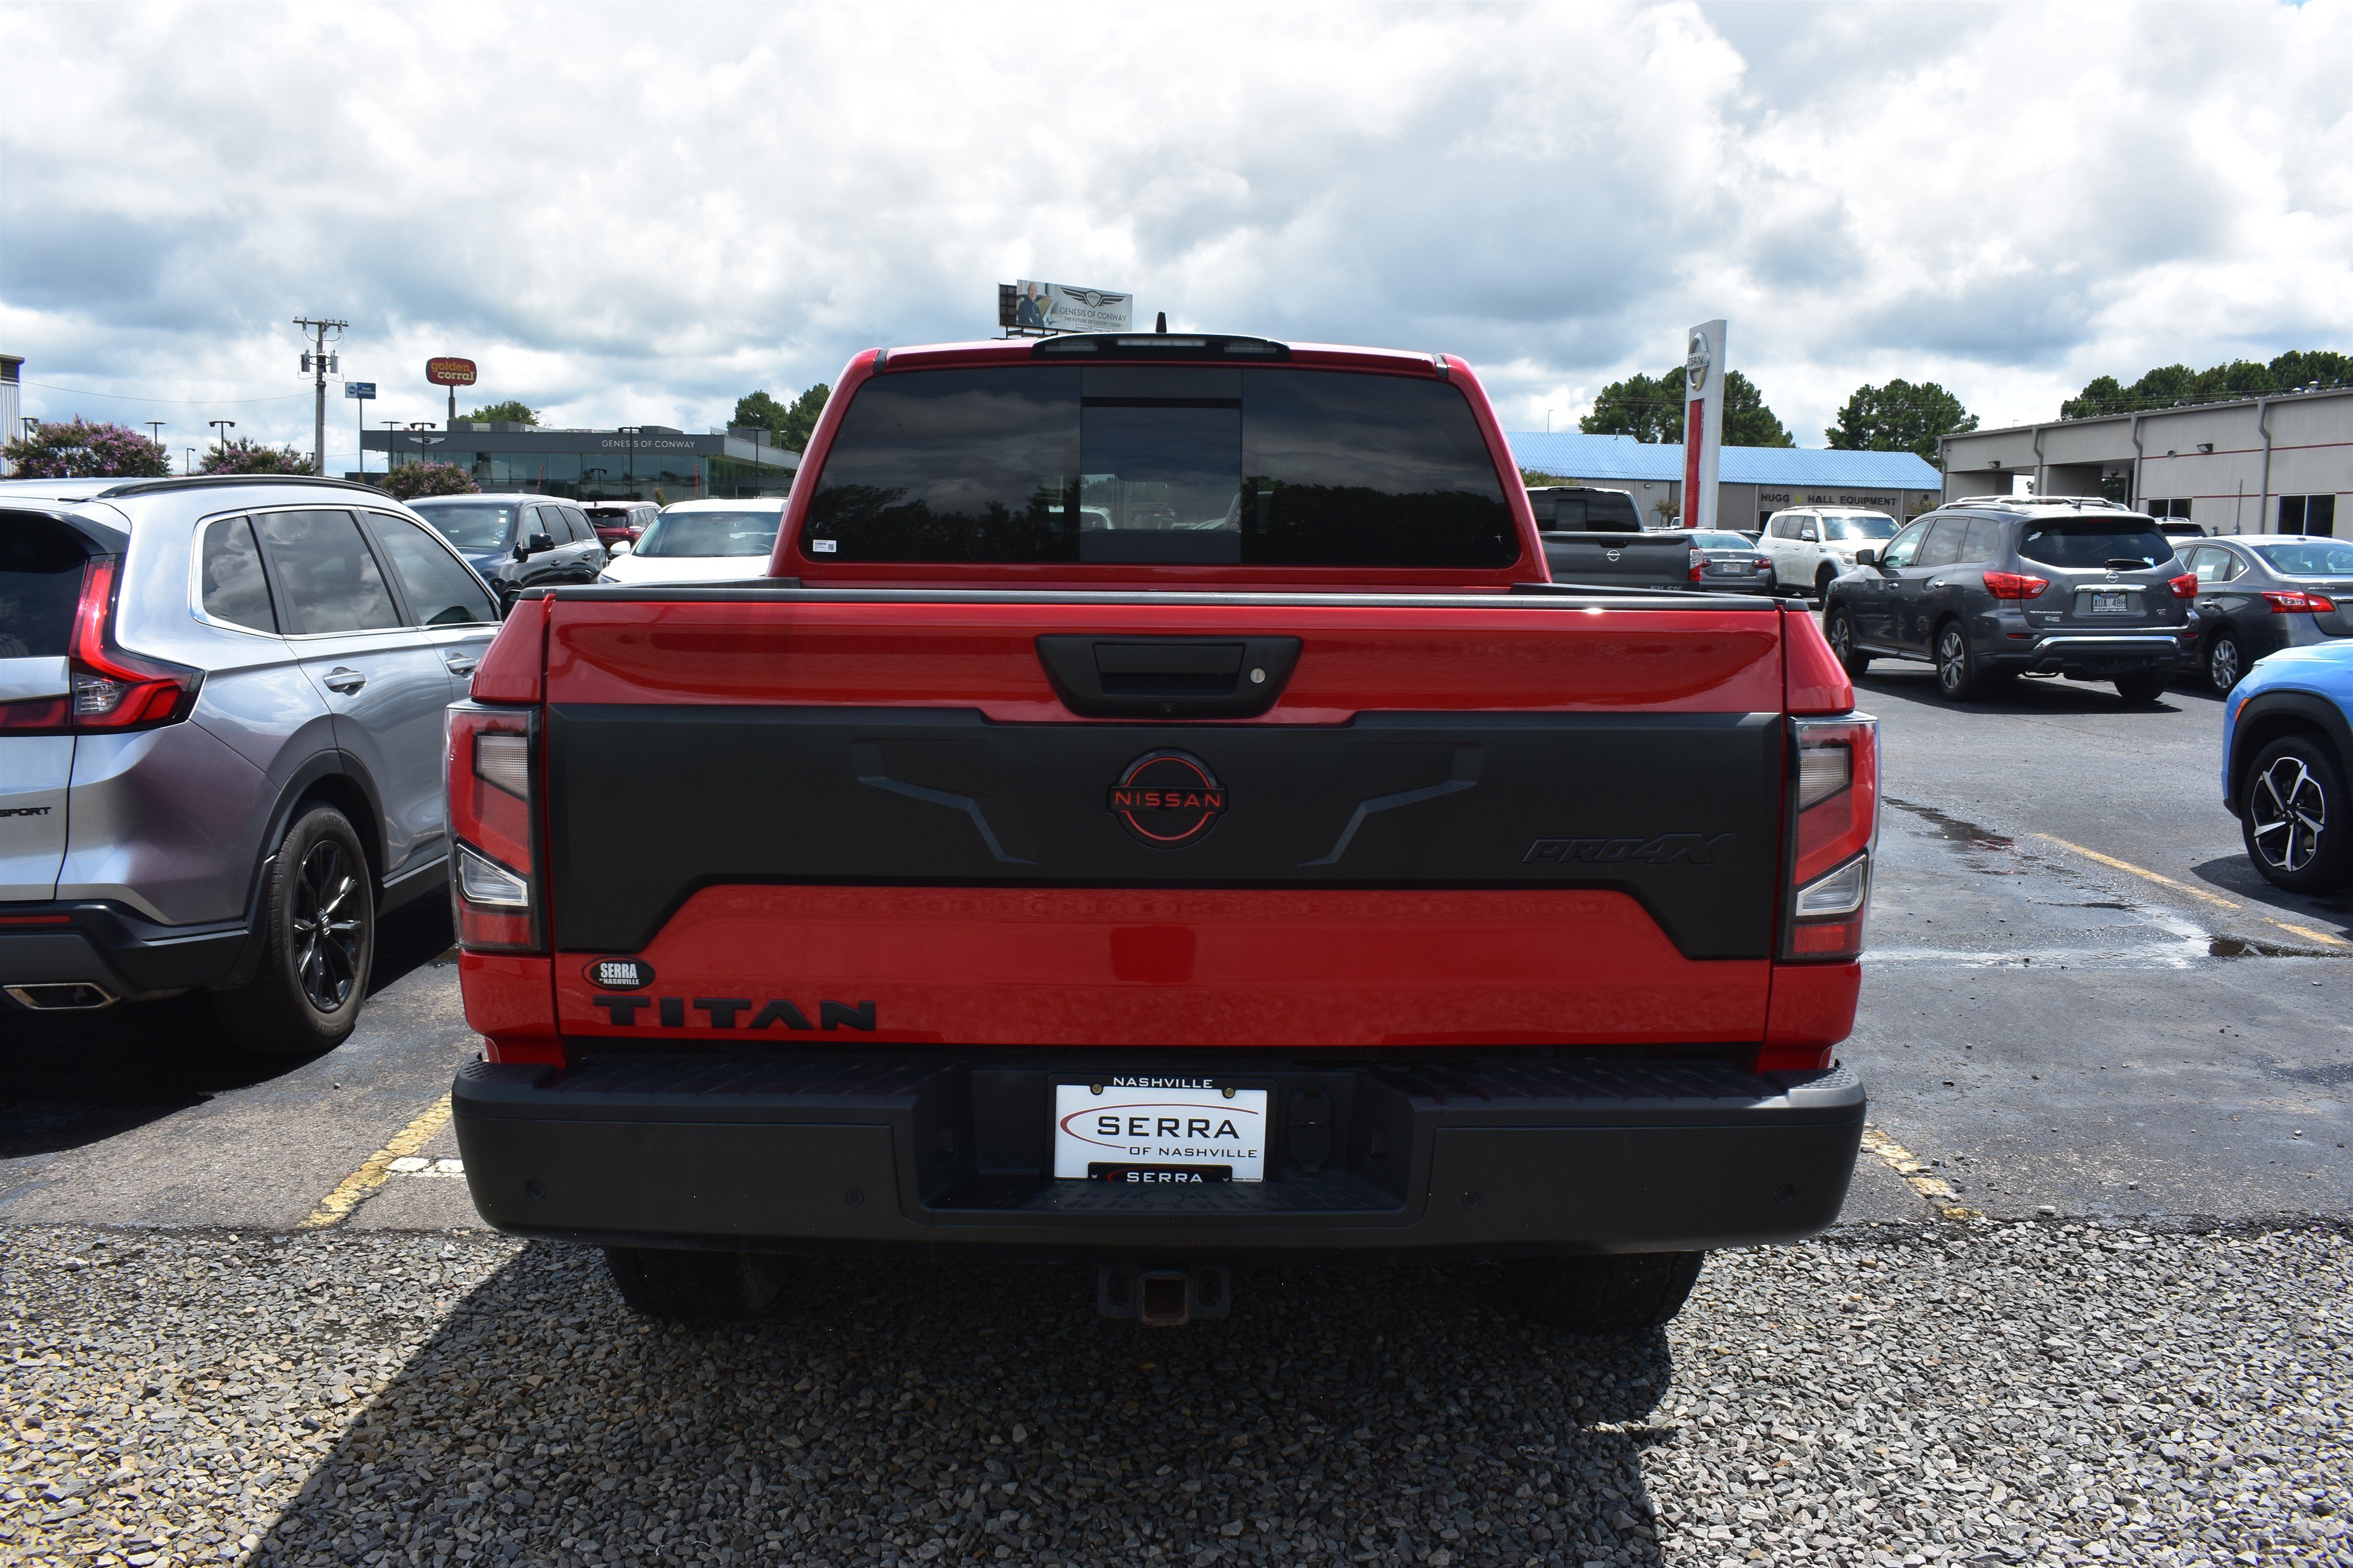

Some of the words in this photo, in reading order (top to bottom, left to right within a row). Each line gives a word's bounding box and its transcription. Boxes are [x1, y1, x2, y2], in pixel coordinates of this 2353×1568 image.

[1060, 307, 1086, 317] GENESIS
[1097, 312, 1127, 322] CONWAY
[431, 362, 470, 372] golden
[437, 371, 475, 380] corral
[1761, 493, 1790, 502] HUGG
[1795, 495, 1802, 503] &
[1808, 495, 1835, 503] HALL
[1840, 496, 1897, 505] EQUIPMENT
[2094, 599, 2107, 608] AUA
[2112, 599, 2126, 608] 48H
[1115, 791, 1221, 807] NISSAN
[0, 806, 51, 817] SPORT
[600, 963, 638, 978] SERRA
[593, 995, 876, 1031] TITAN
[1113, 1077, 1213, 1088] NASHVILLE
[1097, 1115, 1240, 1140] SERRA
[1129, 1146, 1152, 1155] OF
[1159, 1147, 1257, 1158] NASHVILLE
[1127, 1172, 1203, 1183] SERRA
